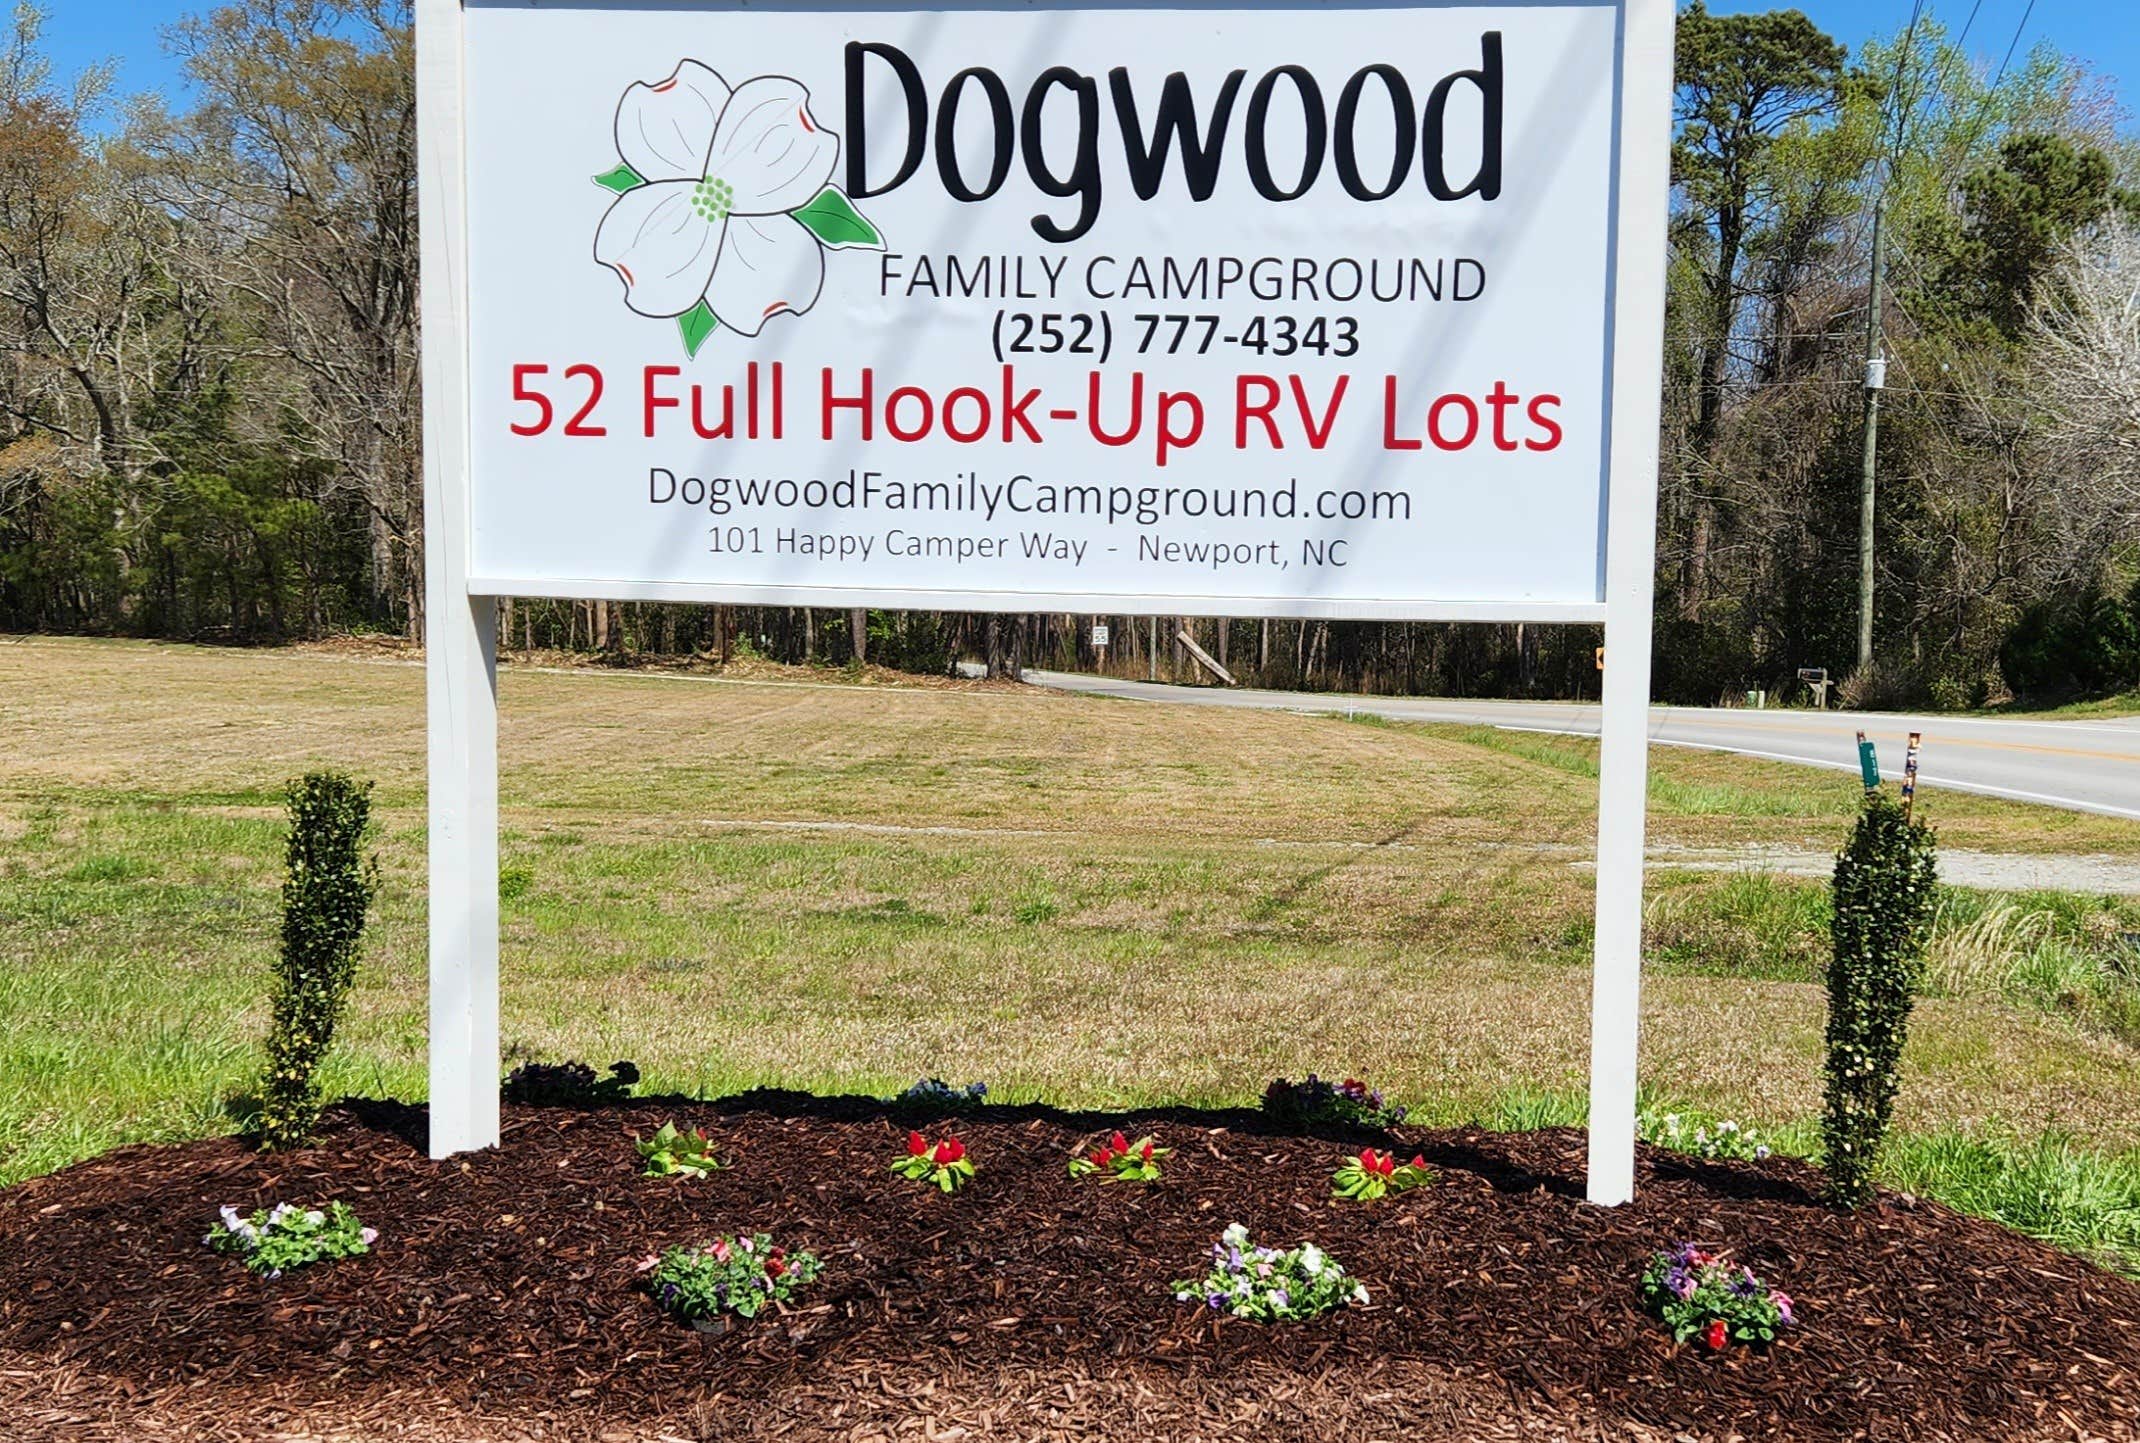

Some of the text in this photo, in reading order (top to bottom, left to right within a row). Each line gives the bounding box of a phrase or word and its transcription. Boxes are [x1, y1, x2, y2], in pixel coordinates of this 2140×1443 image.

[844, 31, 1503, 244] Dogwood
[881, 253, 1487, 303] FAMILY CAMPGROUND
[992, 309, 1359, 364] (252) 777-4343
[510, 361, 1562, 467] 52 Full Hook-Up RV Lots
[650, 467, 1410, 525] DogwoodFamilyCampground.com
[710, 526, 763, 553] 101
[777, 527, 874, 562] Happy
[886, 529, 1009, 564] Camper
[1020, 532, 1088, 566] Way
[1139, 534, 1289, 570] Newport,
[1303, 539, 1348, 567] NC
